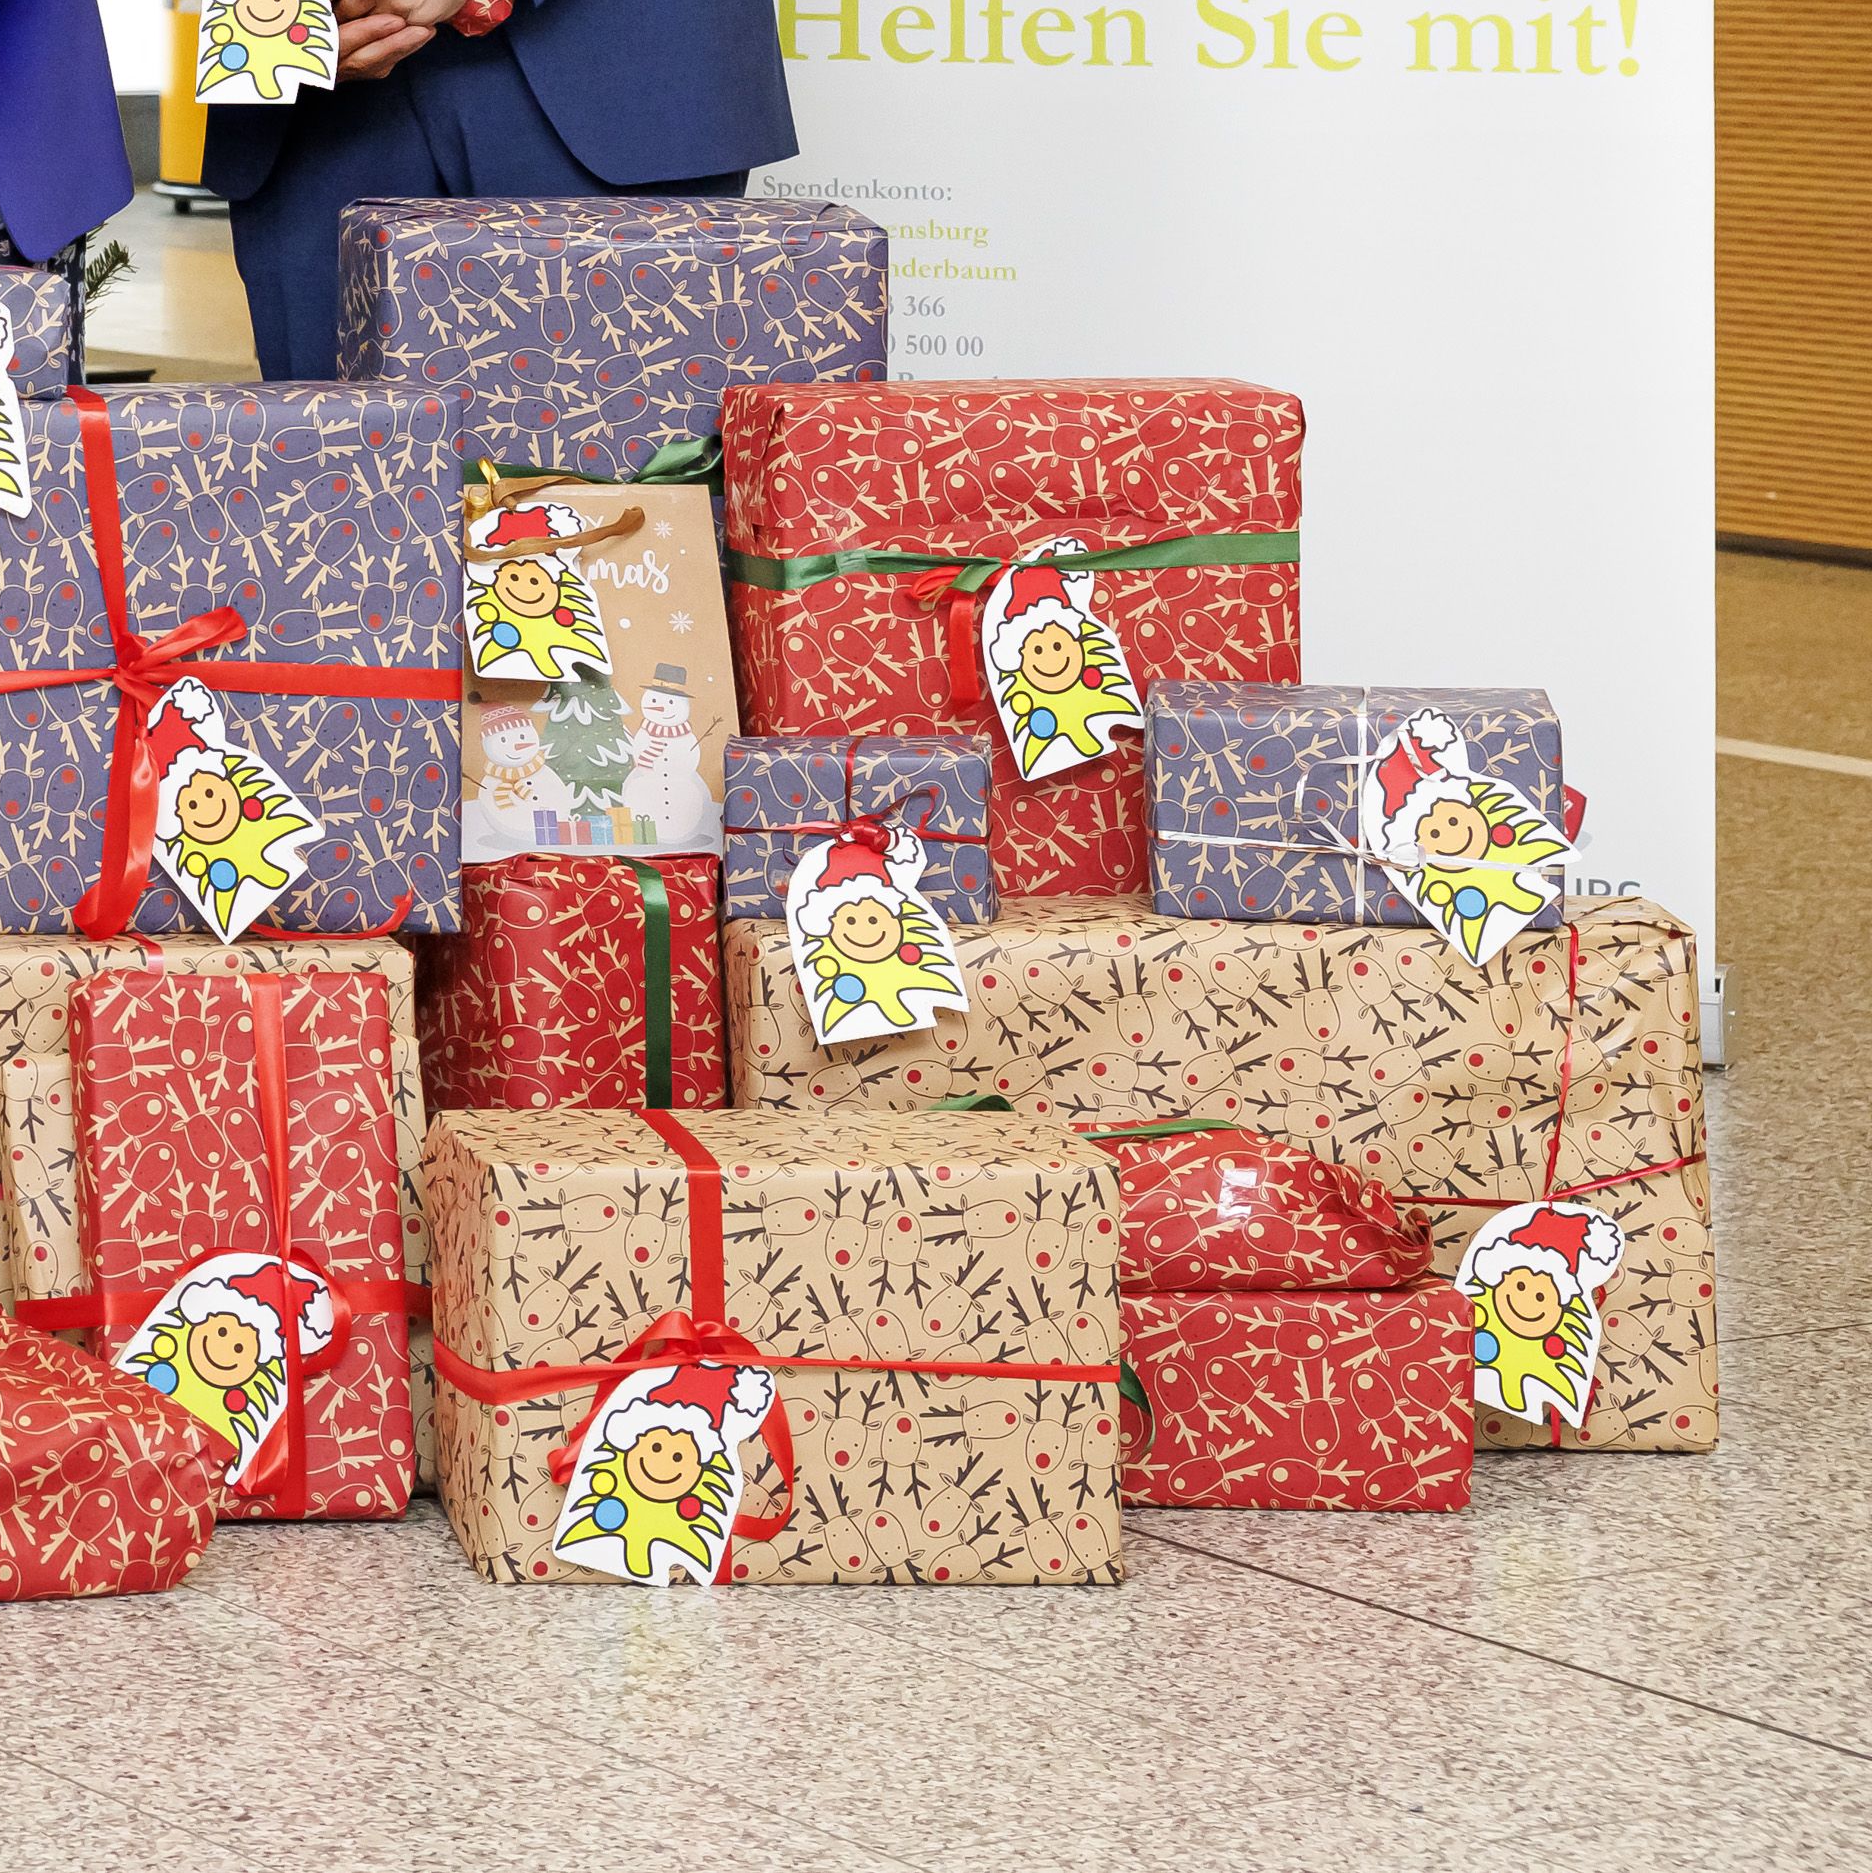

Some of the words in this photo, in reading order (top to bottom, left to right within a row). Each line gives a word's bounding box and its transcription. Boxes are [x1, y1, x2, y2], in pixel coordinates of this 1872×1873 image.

[762, 175, 953, 201] Spendenkonto:
[888, 219, 989, 248] ensburg
[890, 257, 1018, 281] nderbaum
[902, 295, 946, 317] 366
[905, 334, 948, 357] 500
[955, 336, 985, 358] 00
